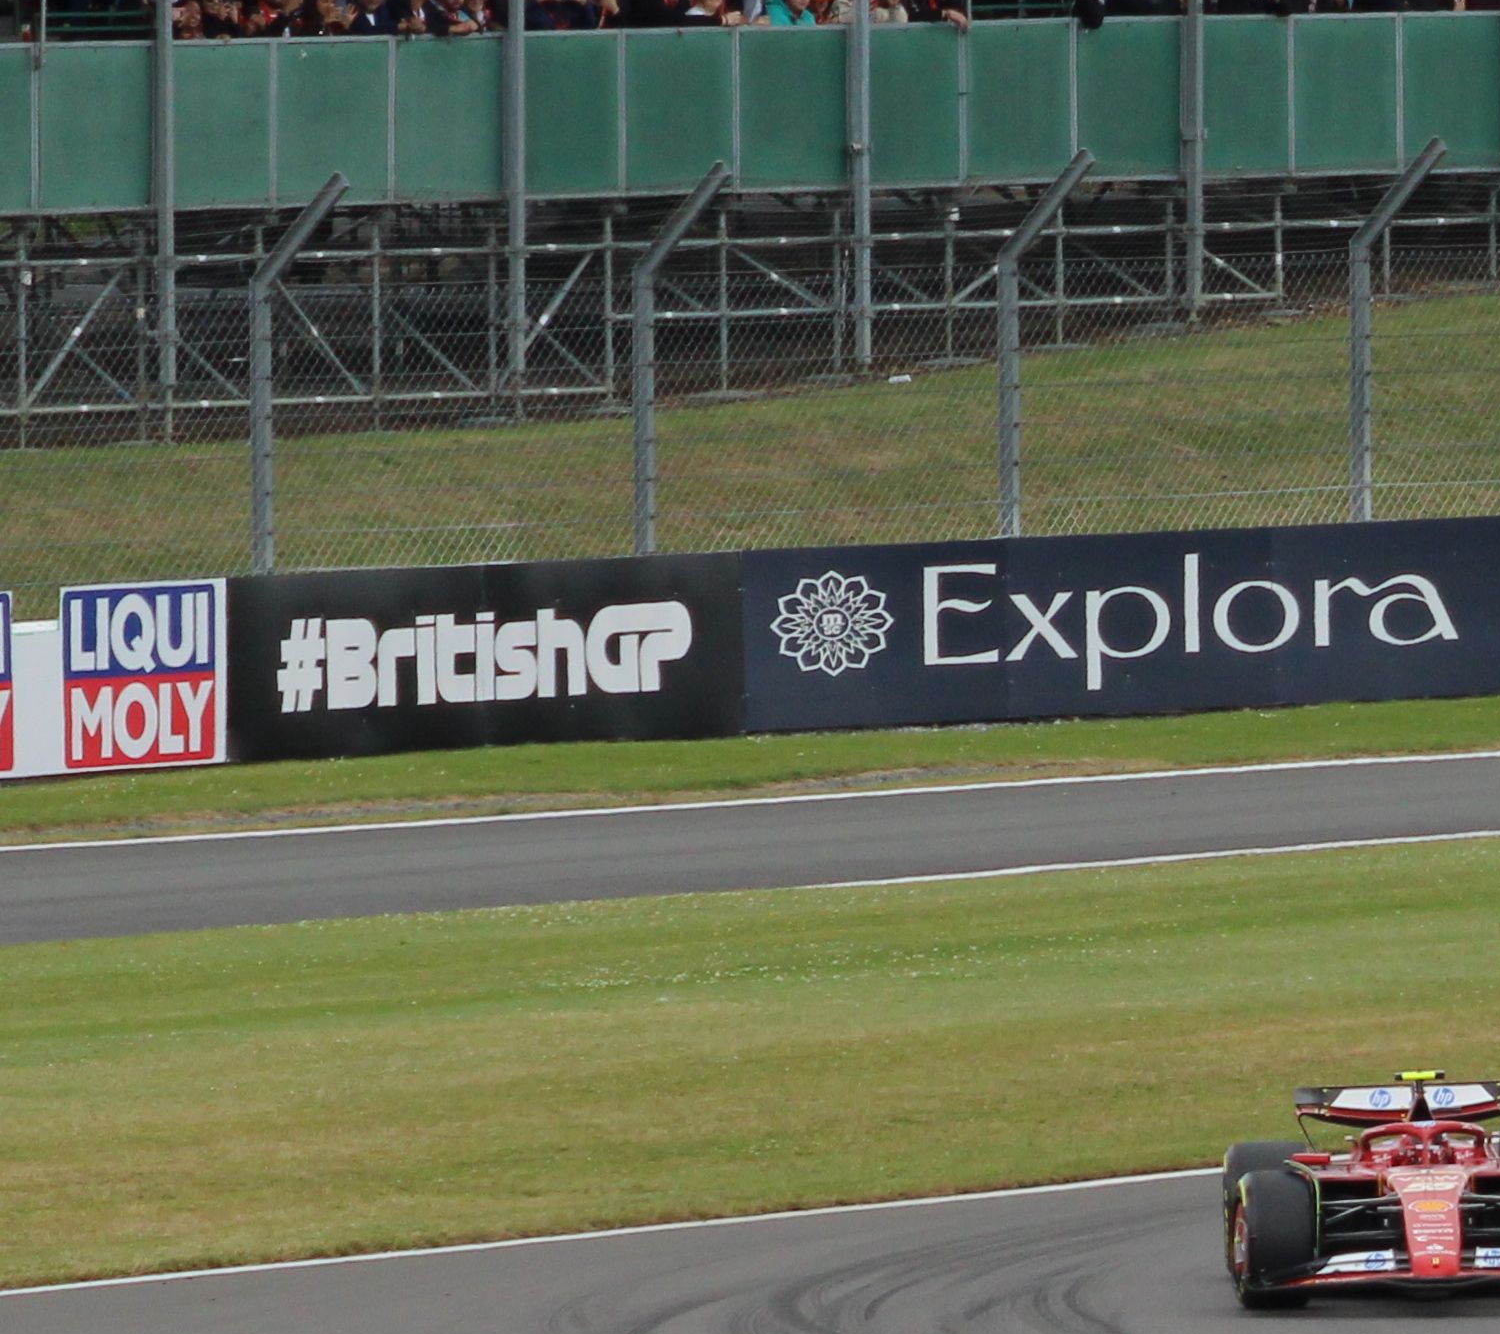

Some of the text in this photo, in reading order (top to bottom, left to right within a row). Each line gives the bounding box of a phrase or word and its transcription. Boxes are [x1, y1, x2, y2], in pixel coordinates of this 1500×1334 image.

[69, 592, 209, 673] LIQUI
[277, 601, 693, 713] #BritishGP
[924, 553, 1459, 690] Explora
[71, 680, 214, 760] MOLY
